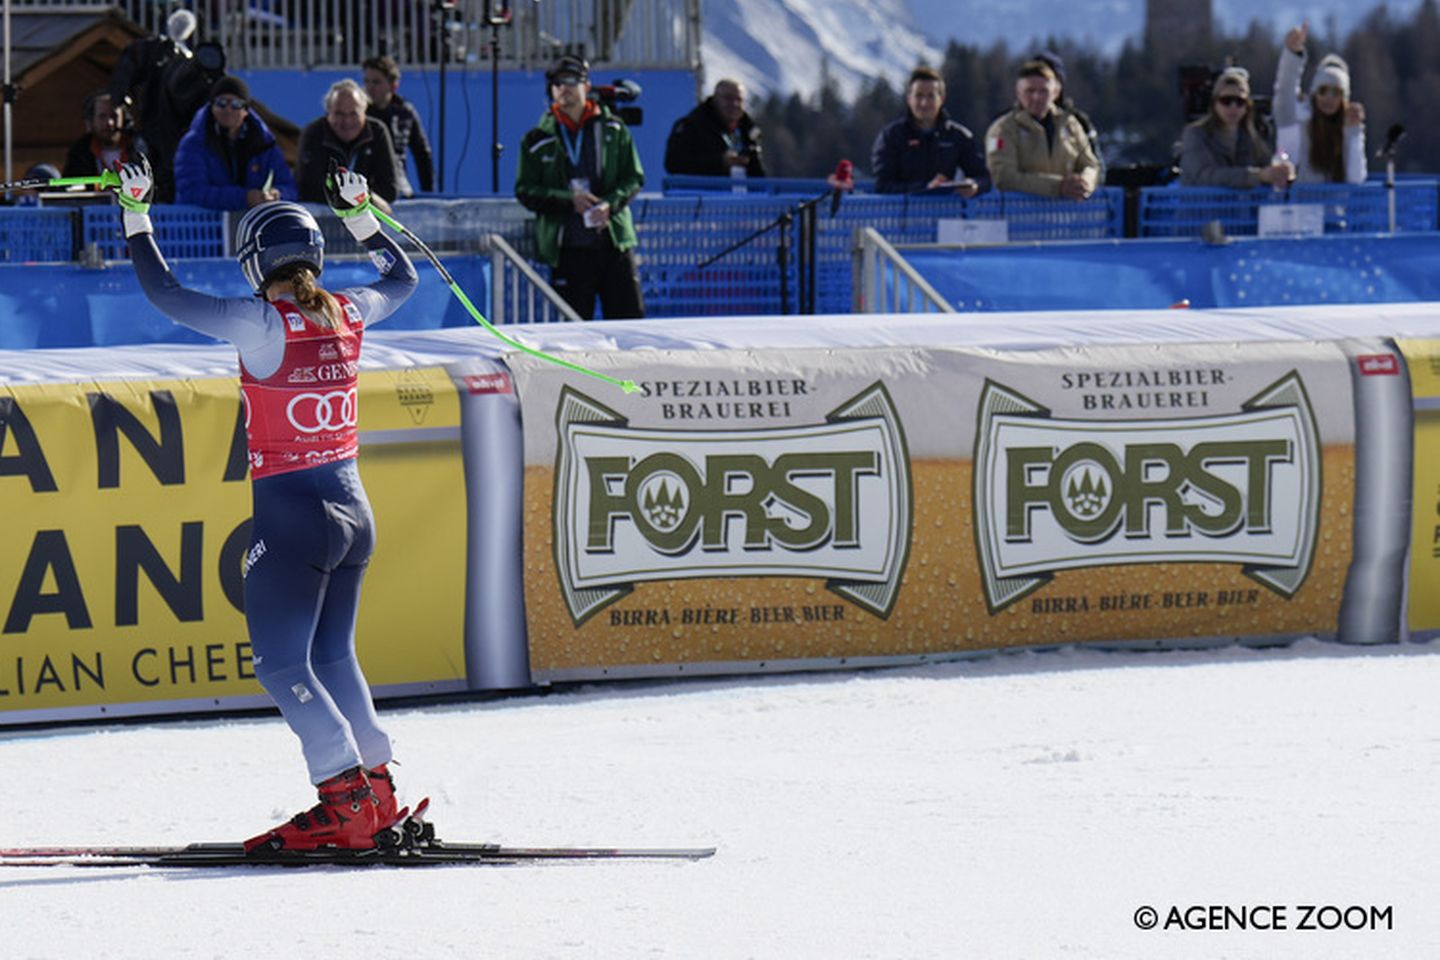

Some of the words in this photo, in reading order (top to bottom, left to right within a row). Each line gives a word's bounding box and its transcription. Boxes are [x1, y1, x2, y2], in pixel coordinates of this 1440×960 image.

[640, 378, 817, 399] SPEZIALBIER-
[1061, 370, 1233, 390] SPEZIALBIER-
[662, 401, 792, 420] BRAUEREI
[1082, 392, 1210, 411] BRAUEREI
[1005, 440, 1294, 545] FORST
[584, 451, 881, 557] FORST
[131, 641, 257, 687] CHEE
